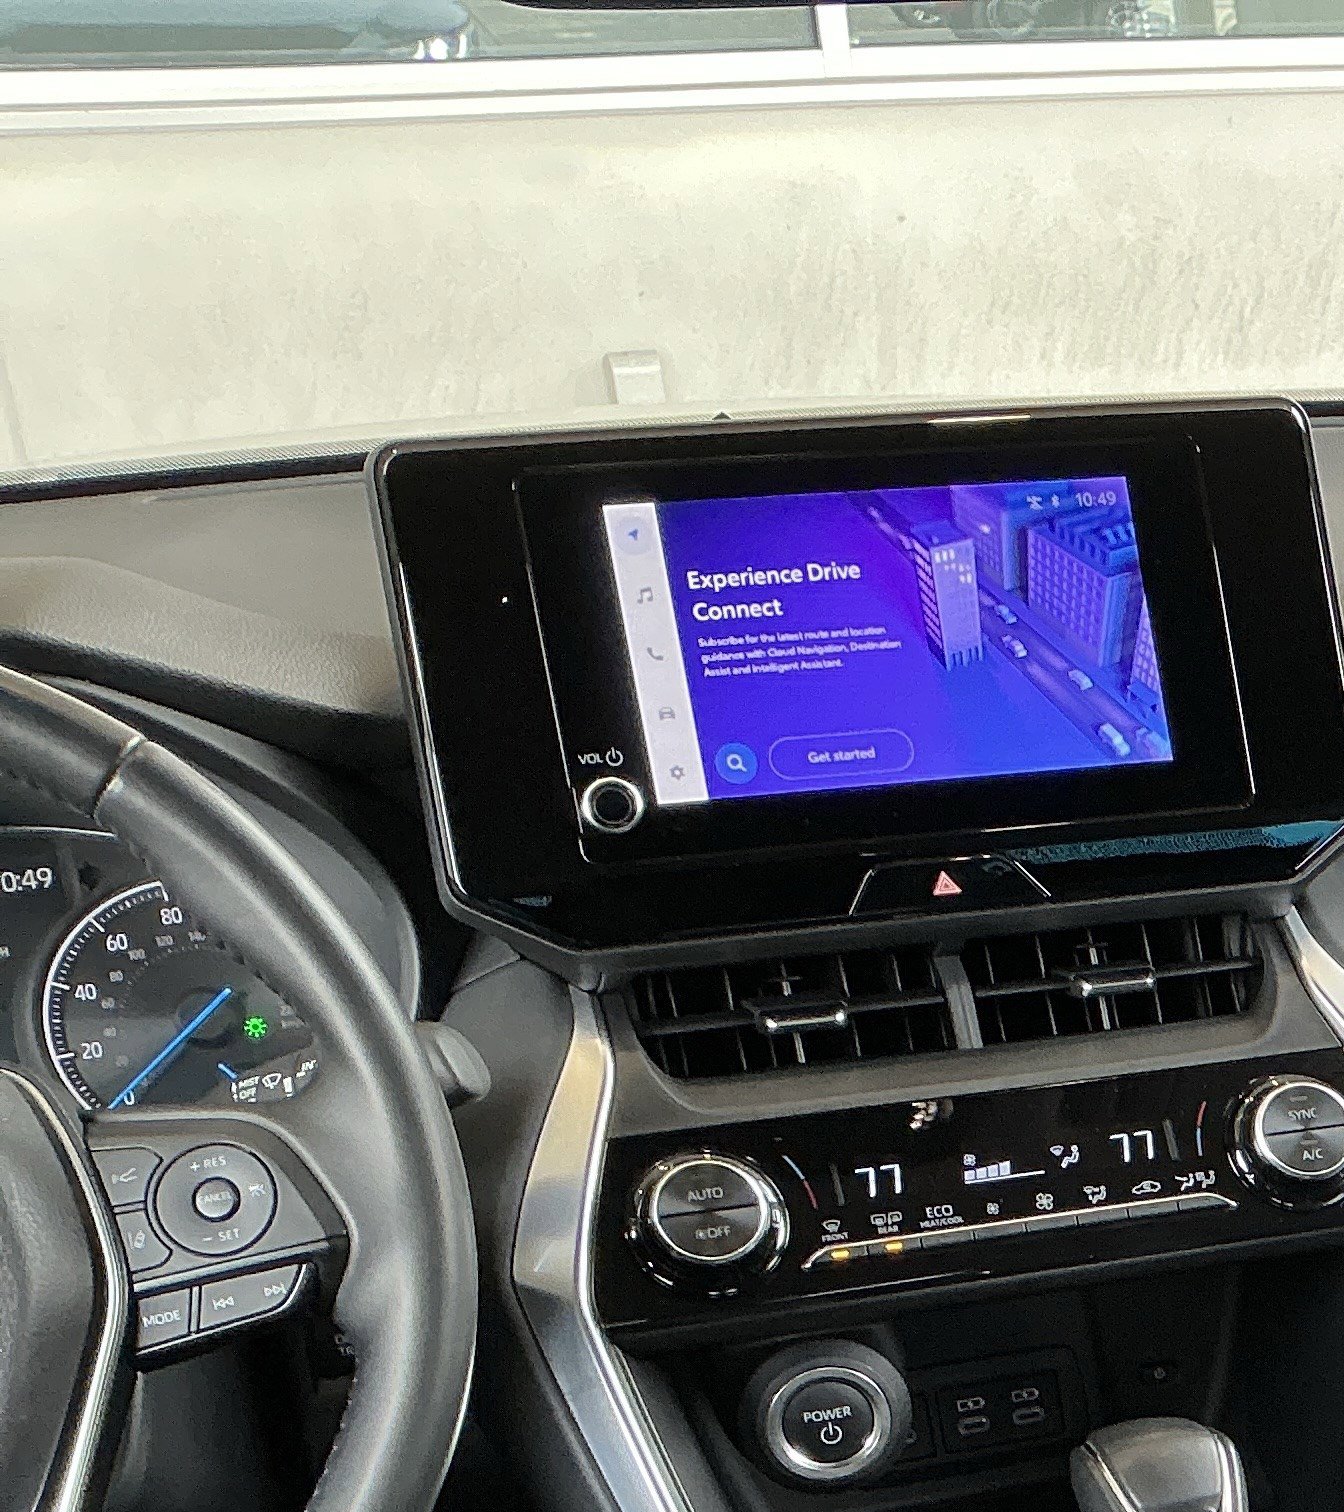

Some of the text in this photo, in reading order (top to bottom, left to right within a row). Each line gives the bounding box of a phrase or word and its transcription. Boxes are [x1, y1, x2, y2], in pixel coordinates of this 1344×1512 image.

[1075, 491, 1117, 507] 10:49
[686, 561, 861, 592] Experience Drive
[692, 599, 784, 621] Connect
[698, 635, 744, 648] Subscribe
[745, 634, 759, 645] for
[759, 632, 776, 643] the
[804, 629, 829, 641] route
[830, 627, 849, 638] and
[849, 625, 887, 637] location
[701, 650, 745, 665] guidance
[745, 648, 766, 659] with
[732, 664, 751, 675] and
[577, 752, 604, 765] VOL
[807, 745, 876, 764] Get started
[159, 907, 183, 925] 80
[106, 933, 129, 952] 60
[74, 983, 98, 1001] 40
[81, 1041, 103, 1060] 20
[123, 1090, 136, 1106] 0
[1287, 1107, 1317, 1121] SYNC
[1109, 1129, 1154, 1163] 77
[203, 1155, 227, 1169] RES
[1302, 1148, 1324, 1162] A/C
[854, 1163, 902, 1199] 77
[687, 1186, 724, 1203] AUTO
[925, 1204, 954, 1219] ECO
[217, 1227, 240, 1242] SET
[821, 1231, 849, 1243] FRONT
[142, 1309, 181, 1328] MODE
[803, 1405, 853, 1424] POWER
